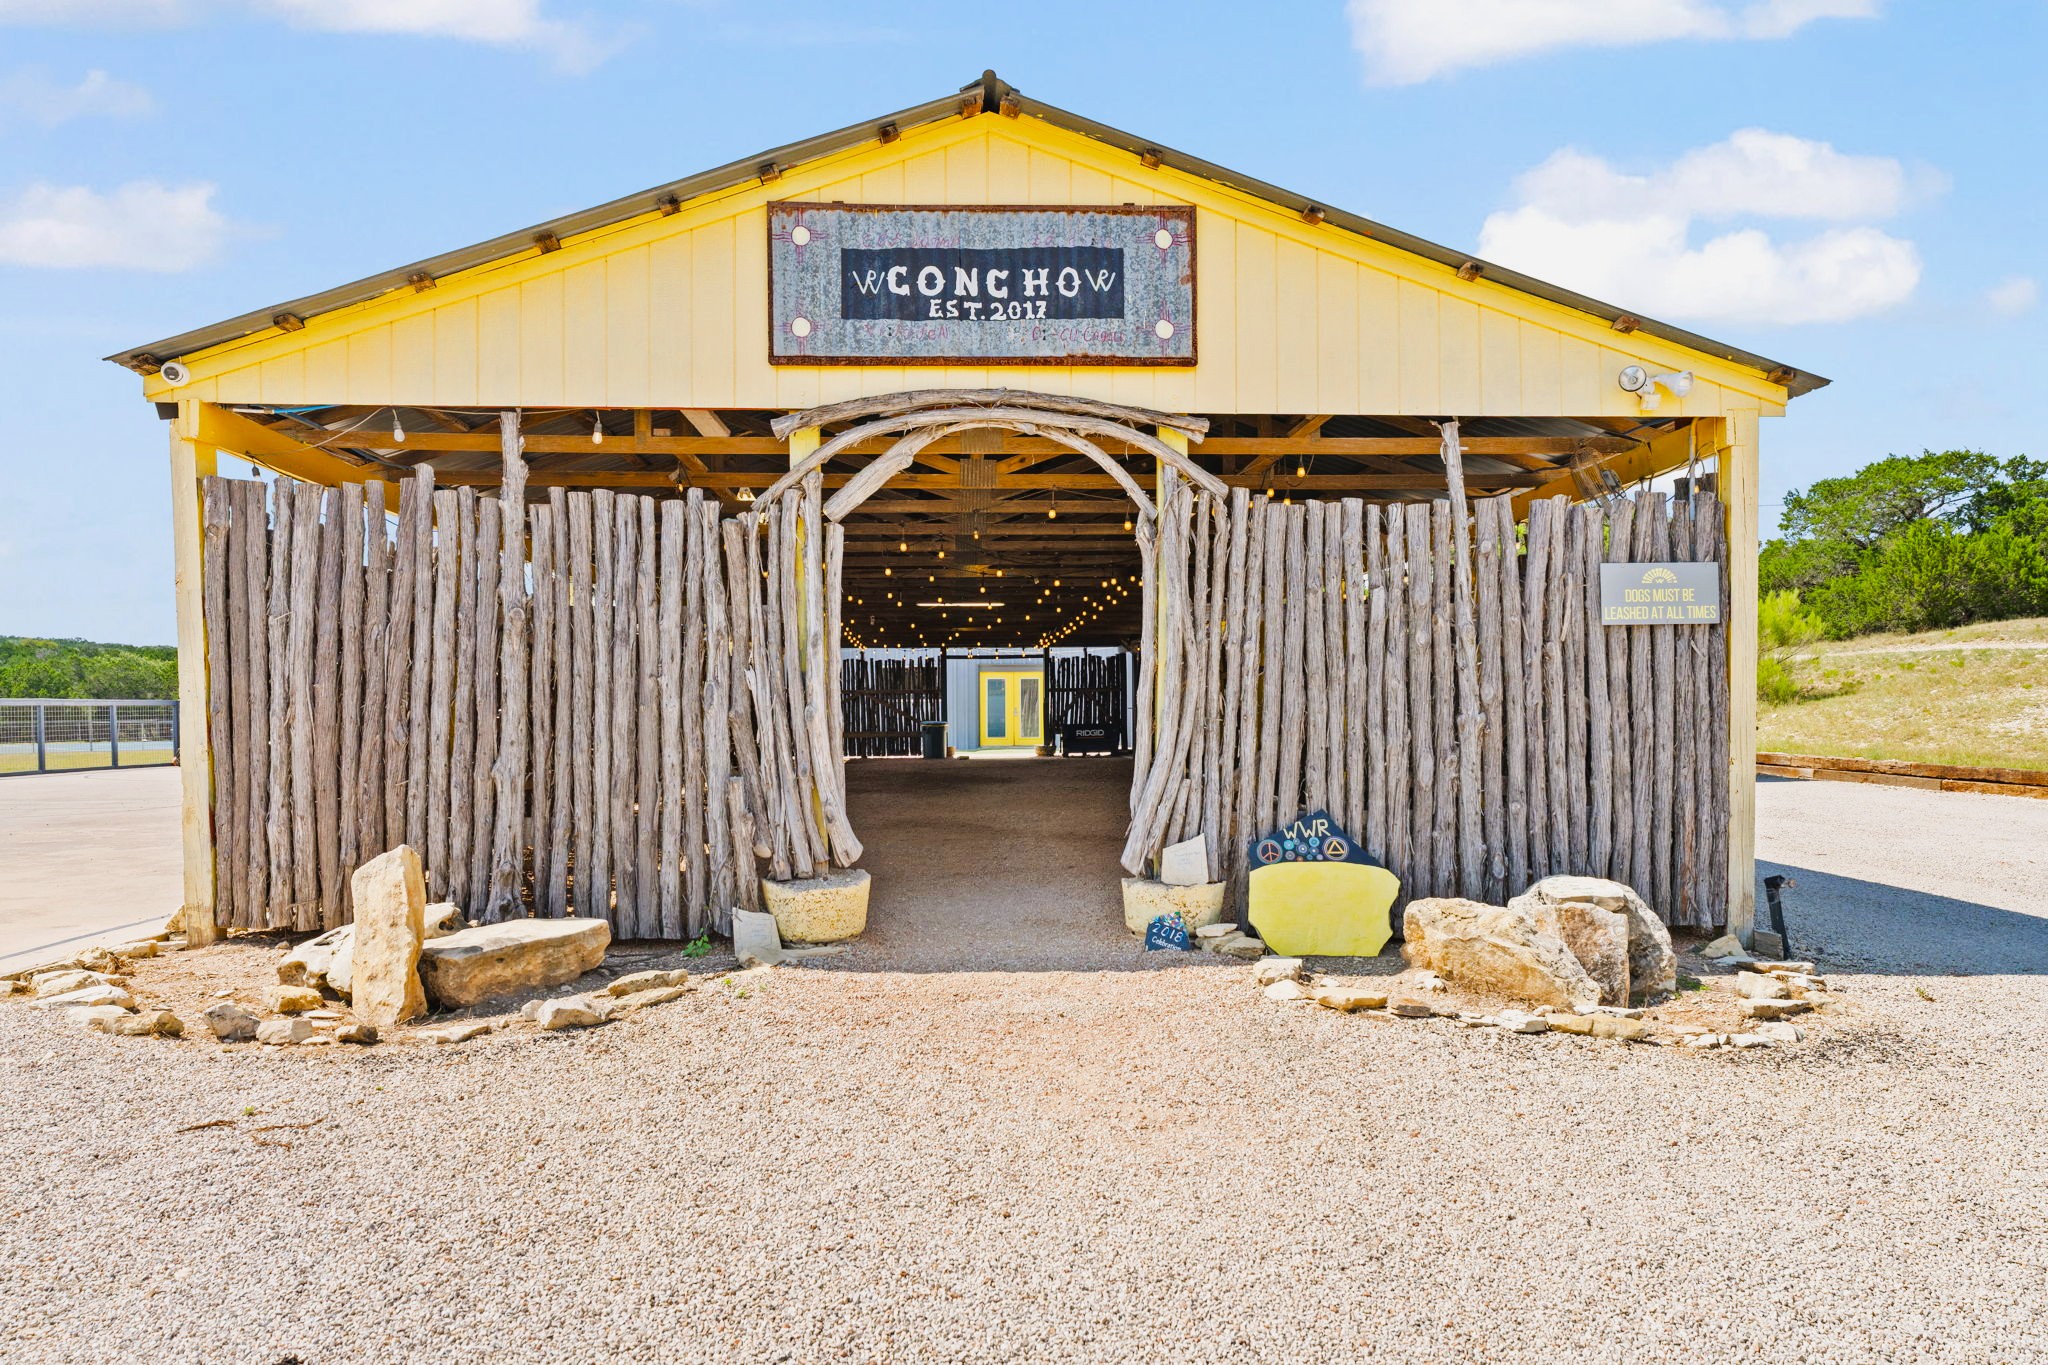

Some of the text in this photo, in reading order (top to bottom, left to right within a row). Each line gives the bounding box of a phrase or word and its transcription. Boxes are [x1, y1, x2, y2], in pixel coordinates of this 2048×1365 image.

[886, 265, 1082, 299] CONCHO
[1625, 588, 1695, 602] DOGS MUST BE
[1604, 605, 1716, 620] LEASHED AT ALL TIMES
[1283, 818, 1331, 839] WWR
[1152, 923, 1184, 943] 2018
